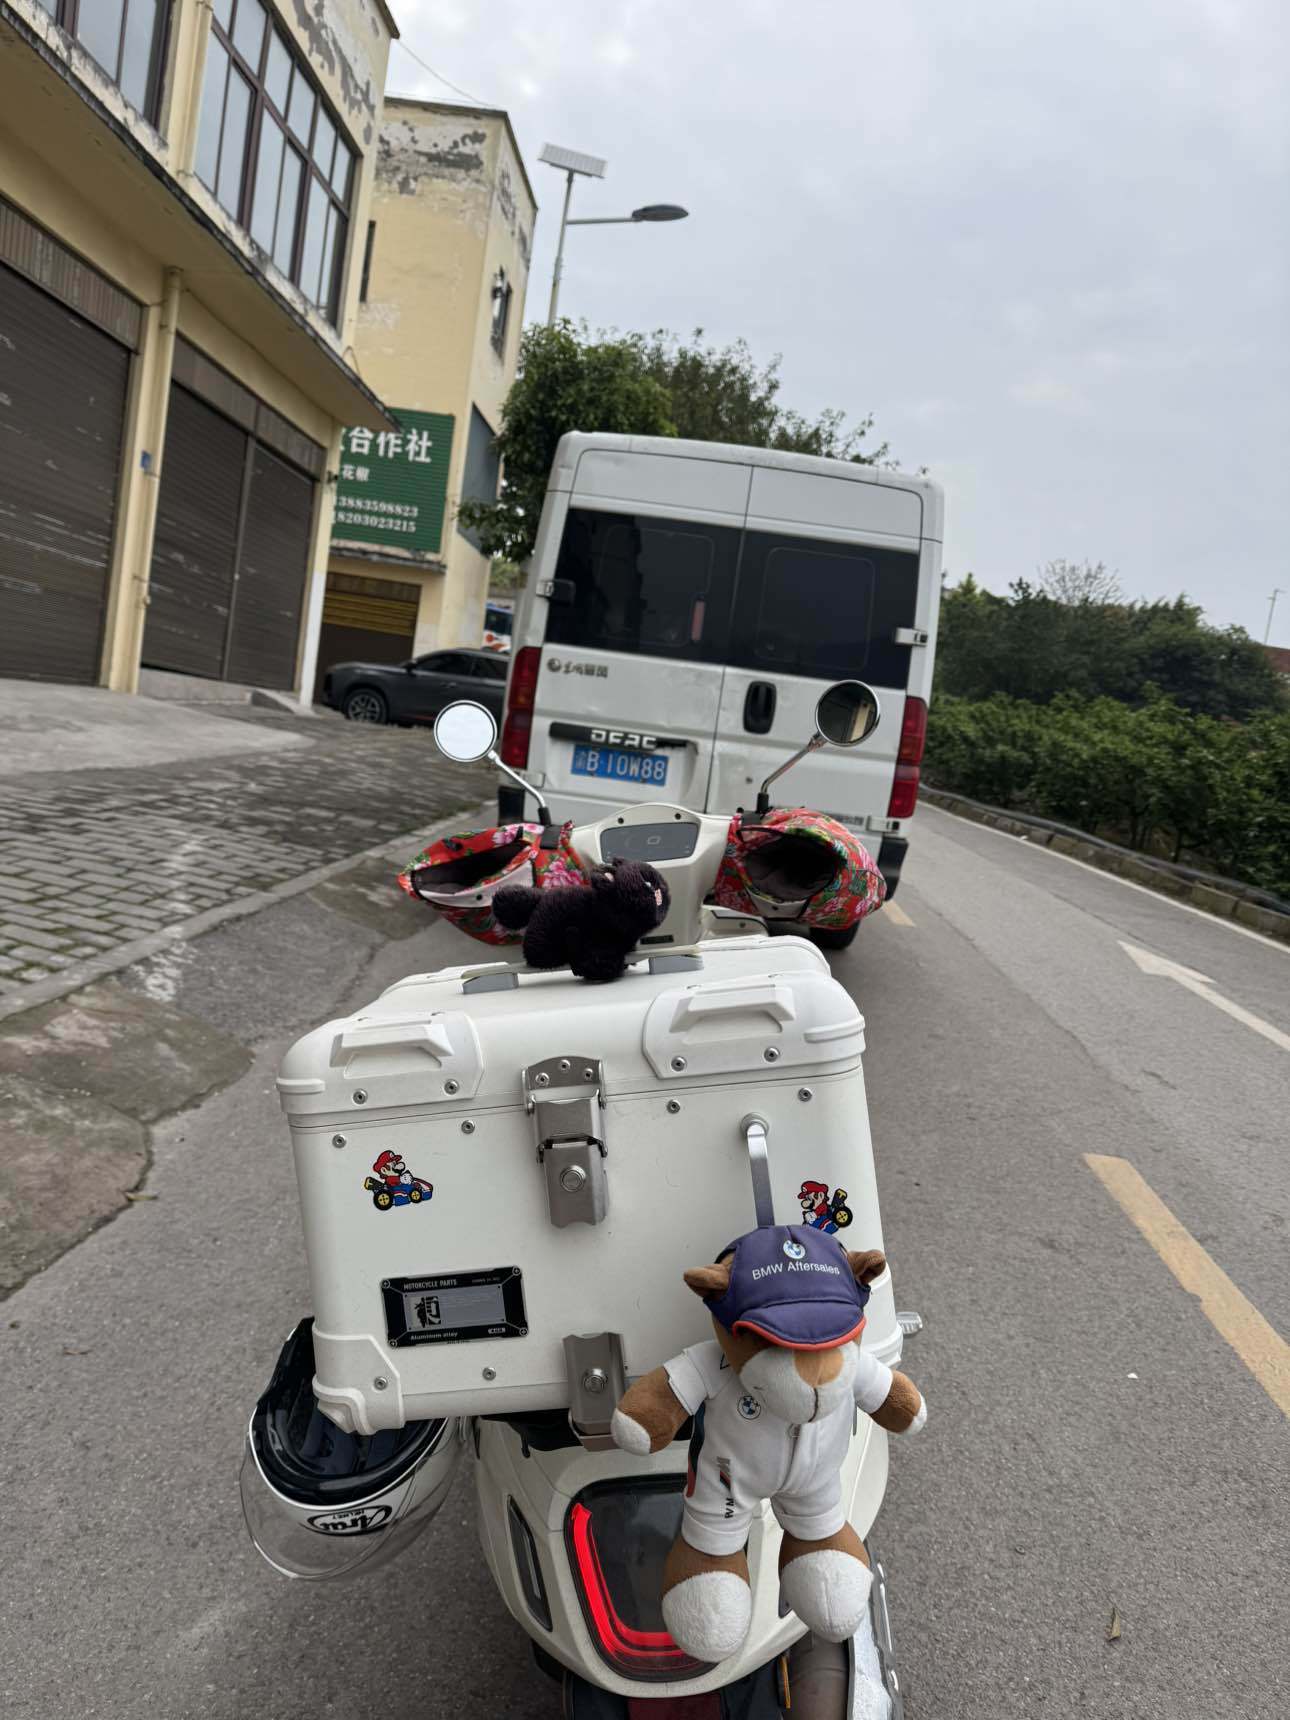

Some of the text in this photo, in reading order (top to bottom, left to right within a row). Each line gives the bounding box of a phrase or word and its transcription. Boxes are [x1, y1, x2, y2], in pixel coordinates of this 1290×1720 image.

[340, 427, 433, 463] 合作社
[752, 1261, 840, 1280] BMW Aftersales
[403, 1278, 457, 1290] MOTORCYCLE PARTS
